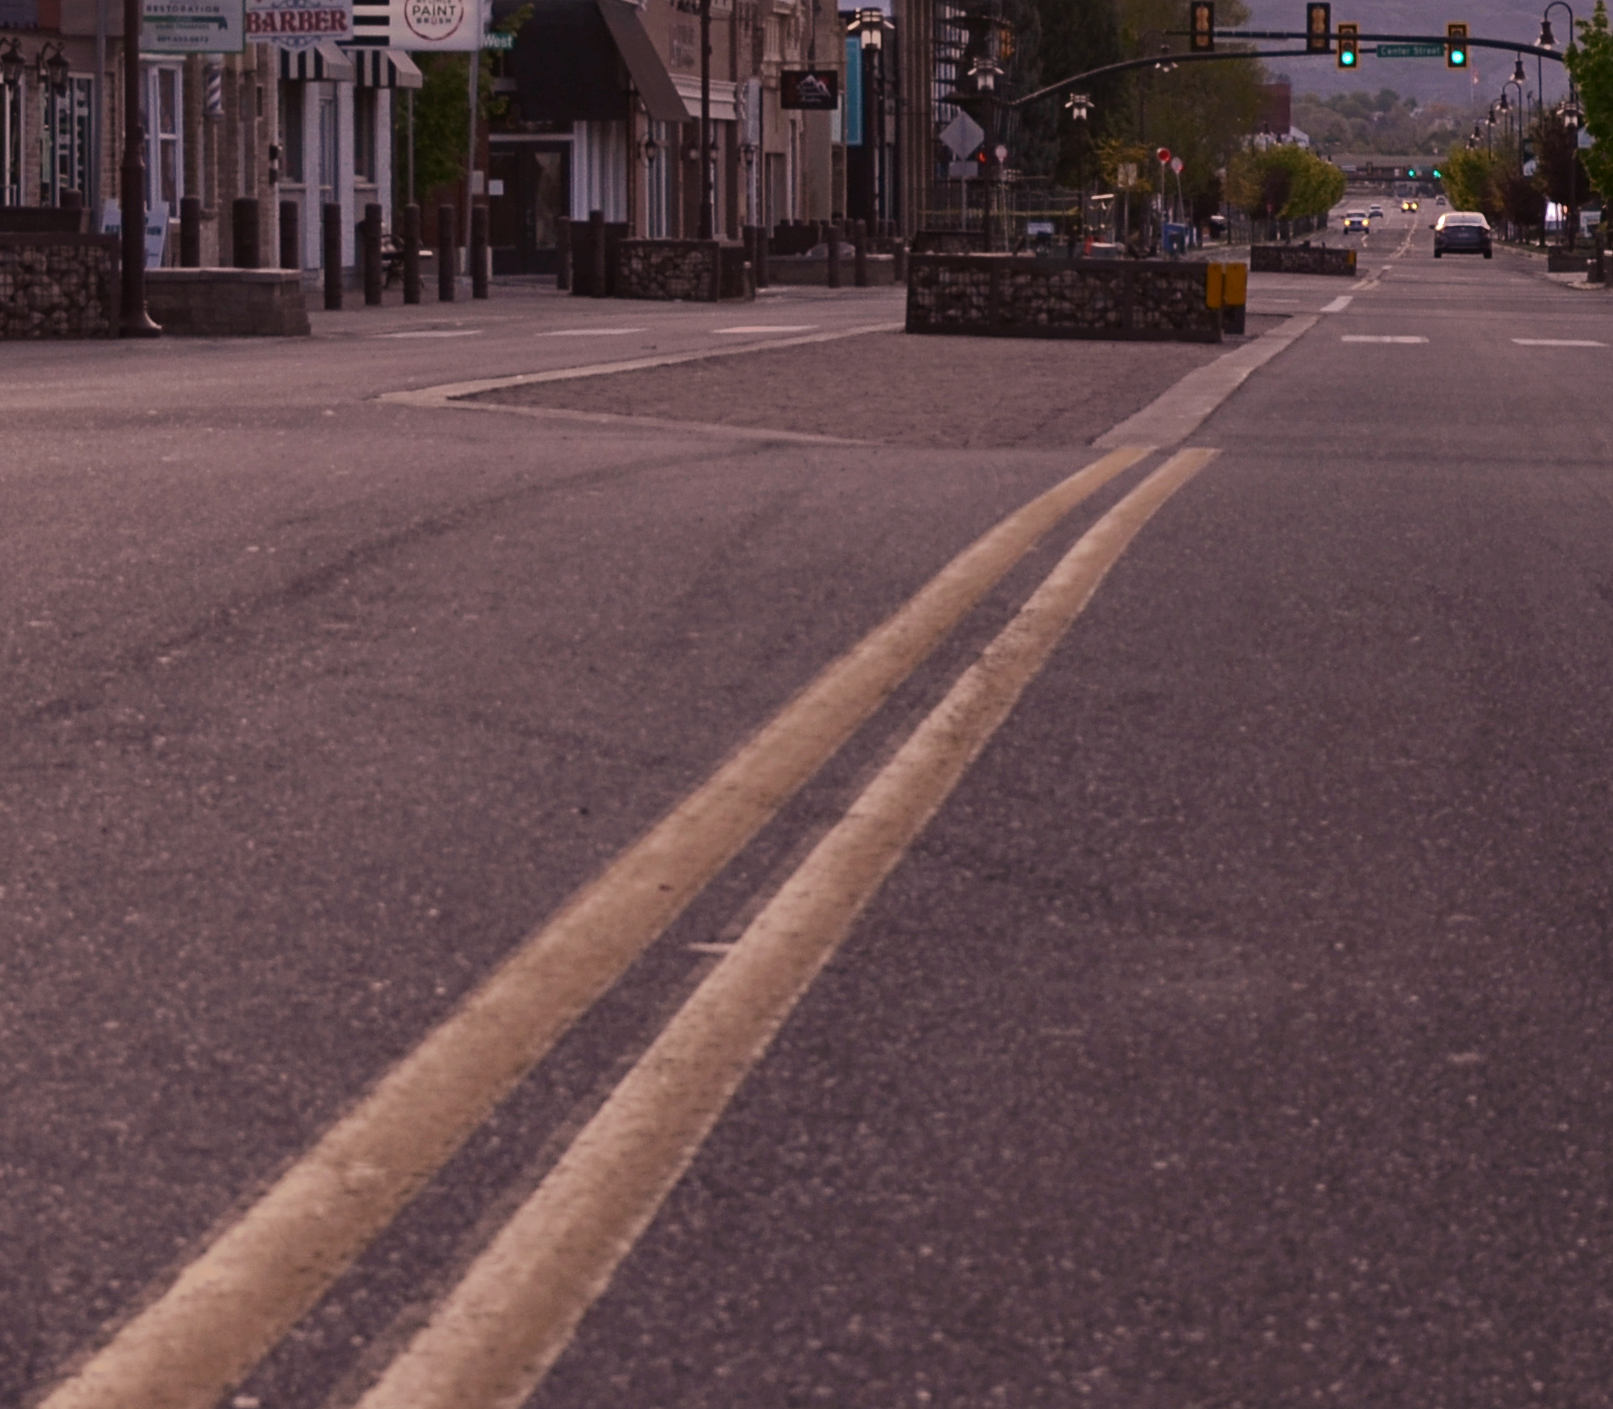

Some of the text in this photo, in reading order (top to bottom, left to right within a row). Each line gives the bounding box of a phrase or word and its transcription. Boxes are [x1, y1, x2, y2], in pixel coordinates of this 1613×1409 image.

[146, 5, 220, 13] RESTORATION
[412, 5, 457, 16] PAINT
[245, 10, 348, 34] BARBER
